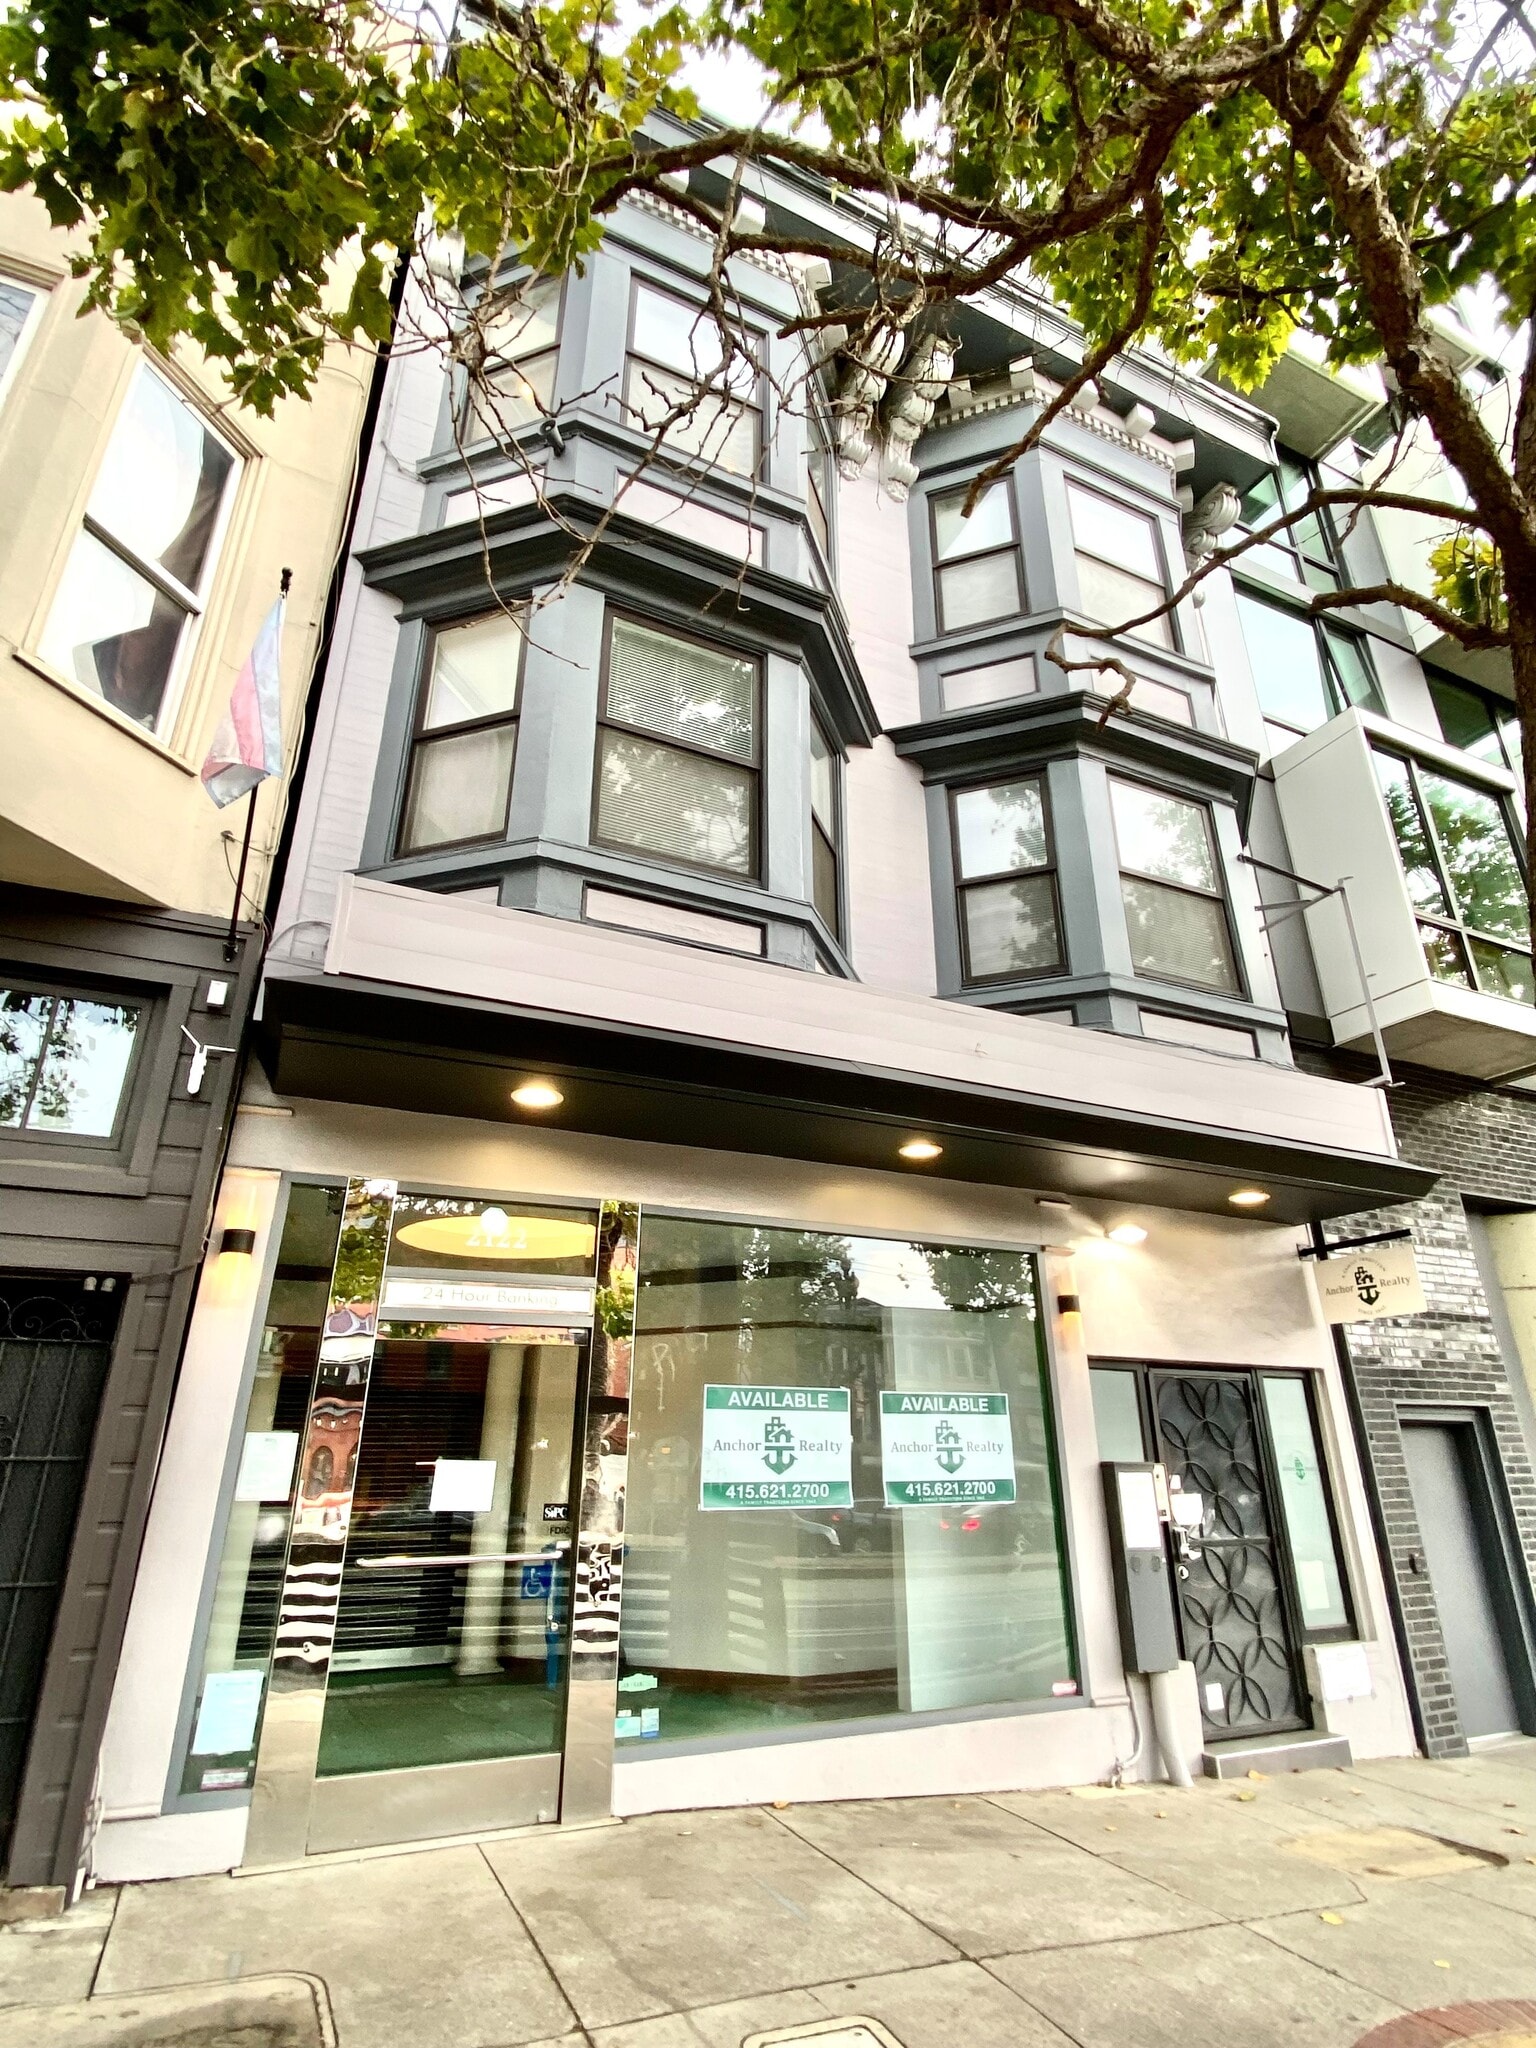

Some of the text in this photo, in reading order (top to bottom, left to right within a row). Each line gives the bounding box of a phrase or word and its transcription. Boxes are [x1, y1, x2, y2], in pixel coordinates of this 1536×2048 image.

[1325, 1275, 1411, 1296] Anchor Realty
[423, 1286, 558, 1308] 24 Hour Banking
[727, 1390, 829, 1409] AVAILABLE
[901, 1395, 989, 1413] AVAILABLE
[713, 1438, 843, 1454] Anchor Realty
[890, 1440, 1004, 1455] Anchor Realty
[725, 1483, 830, 1499] 415.621.2700
[905, 1481, 996, 1497] 415.621.2700
[550, 1526, 570, 1535] FDIC
